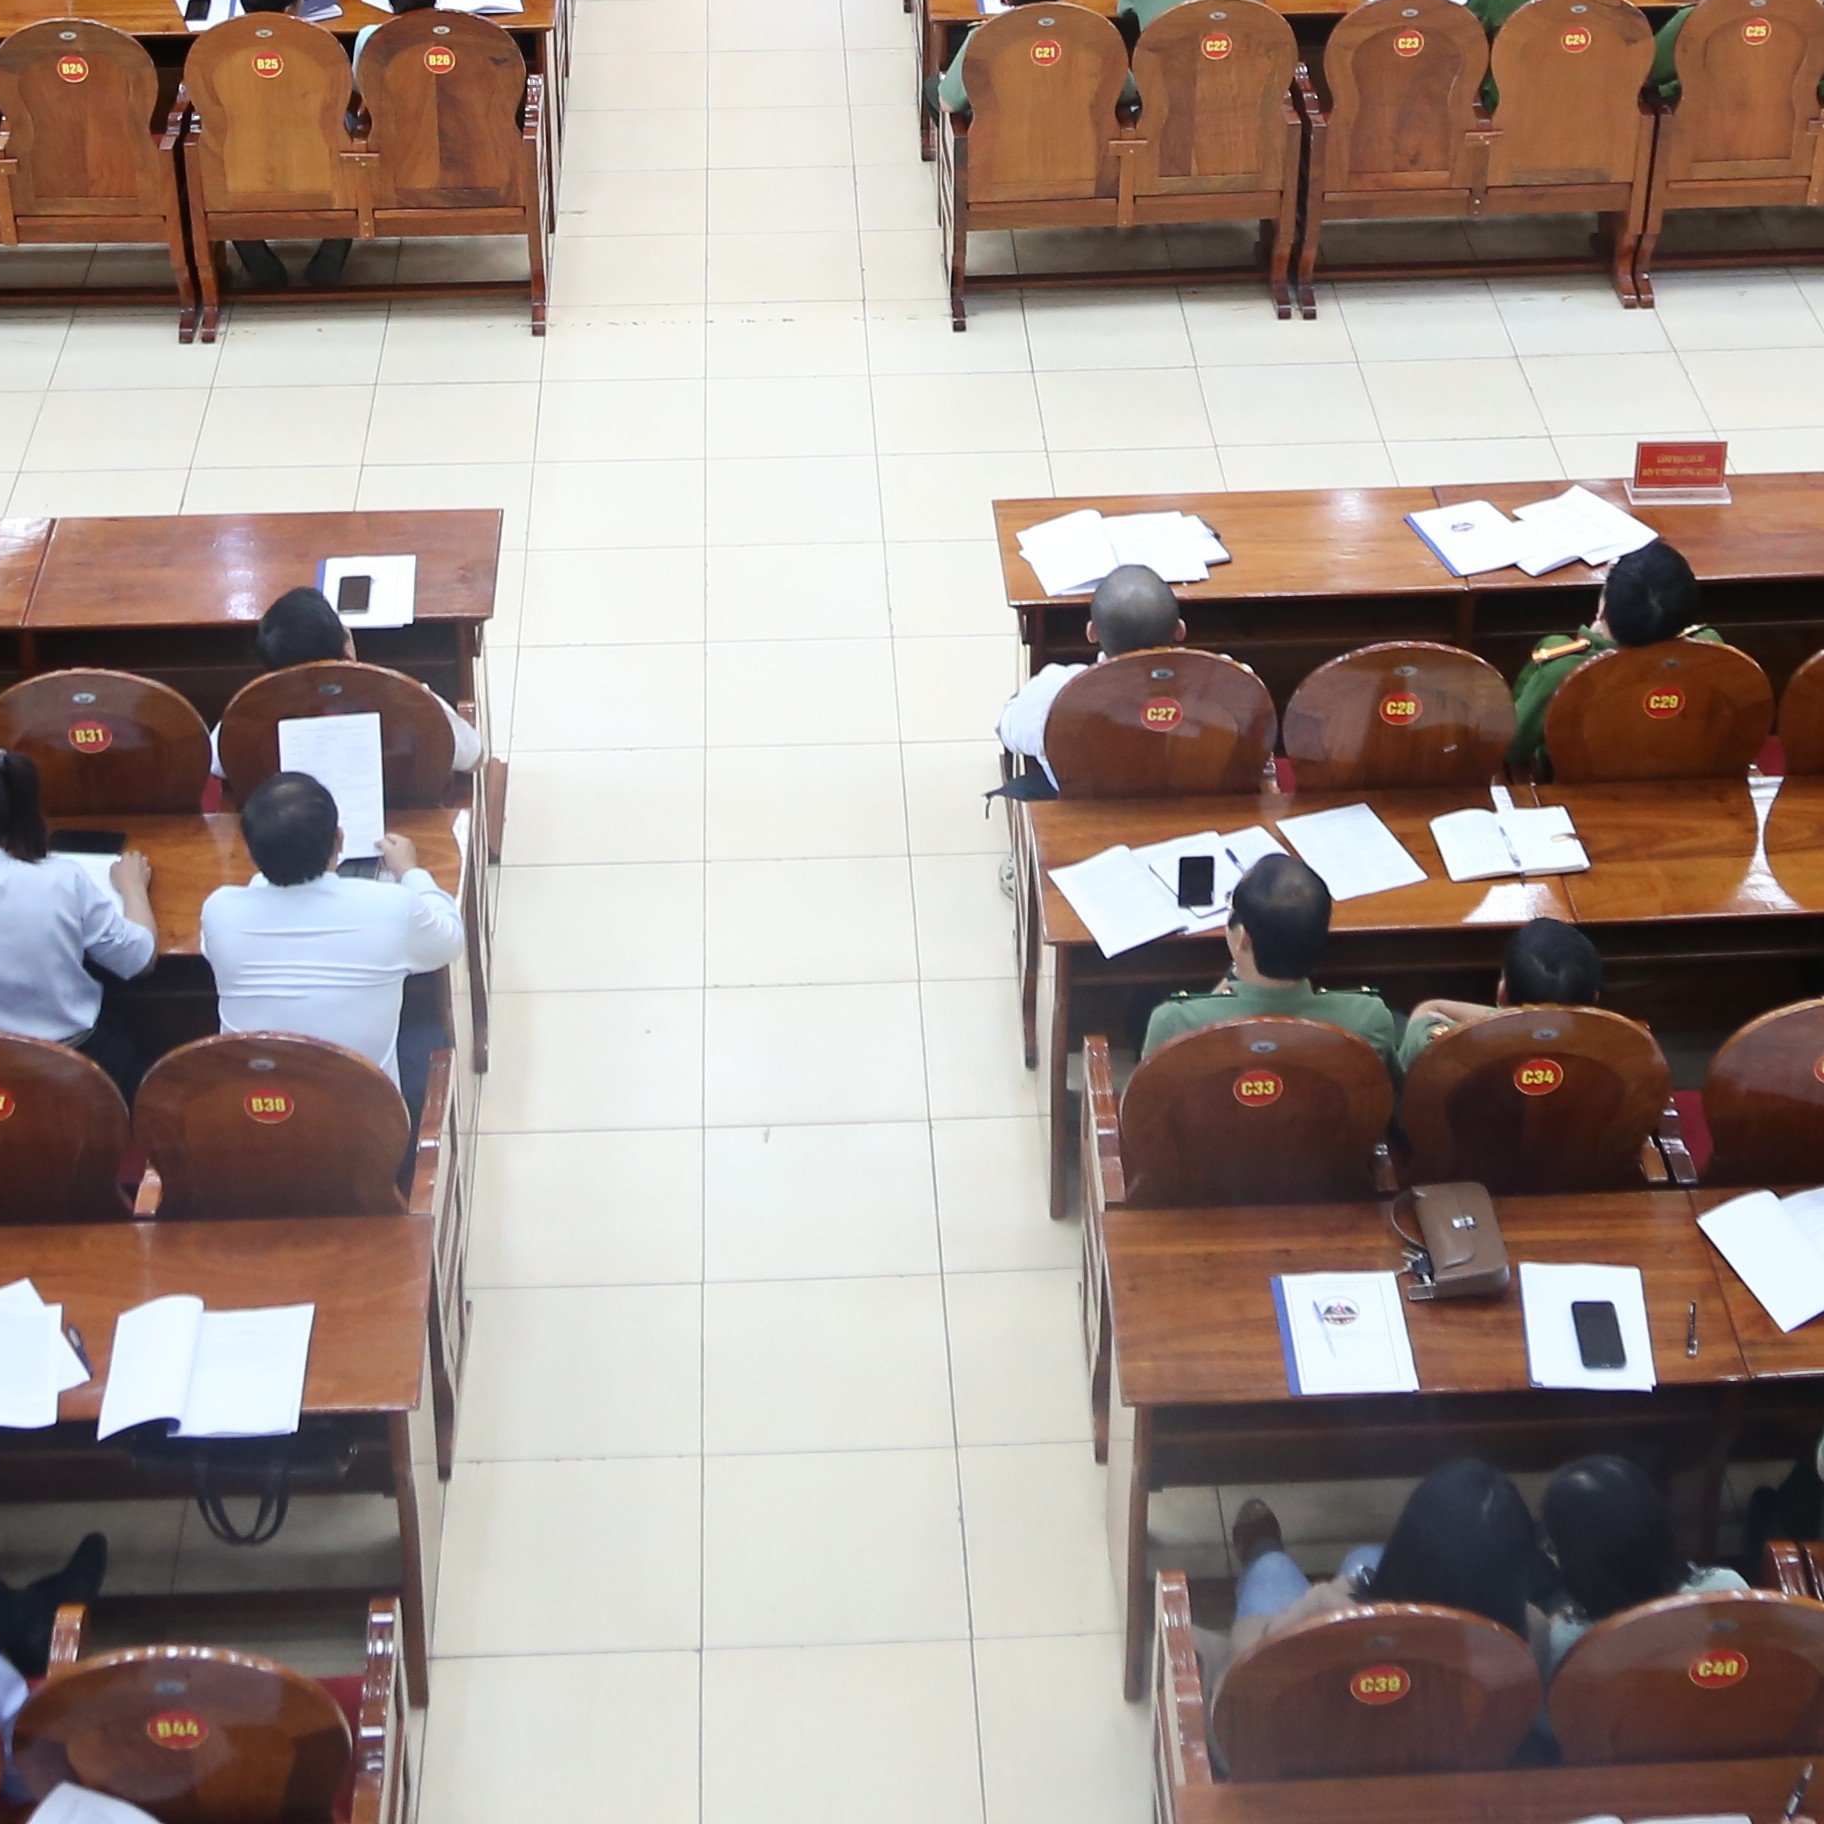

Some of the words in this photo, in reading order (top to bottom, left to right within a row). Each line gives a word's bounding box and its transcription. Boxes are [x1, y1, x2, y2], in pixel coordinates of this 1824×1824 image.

[1205, 40, 1228, 52] C22
[1397, 37, 1420, 49] C23
[1565, 33, 1587, 46] C24
[1035, 46, 1056, 59] C21
[61, 63, 84, 75] B24
[256, 58, 279, 71] B25
[1386, 700, 1416, 715] C28
[1649, 694, 1679, 709] C29
[1146, 707, 1177, 722] C27
[74, 728, 104, 744] B31
[1521, 1069, 1556, 1085] C34
[1241, 1080, 1275, 1096] C33
